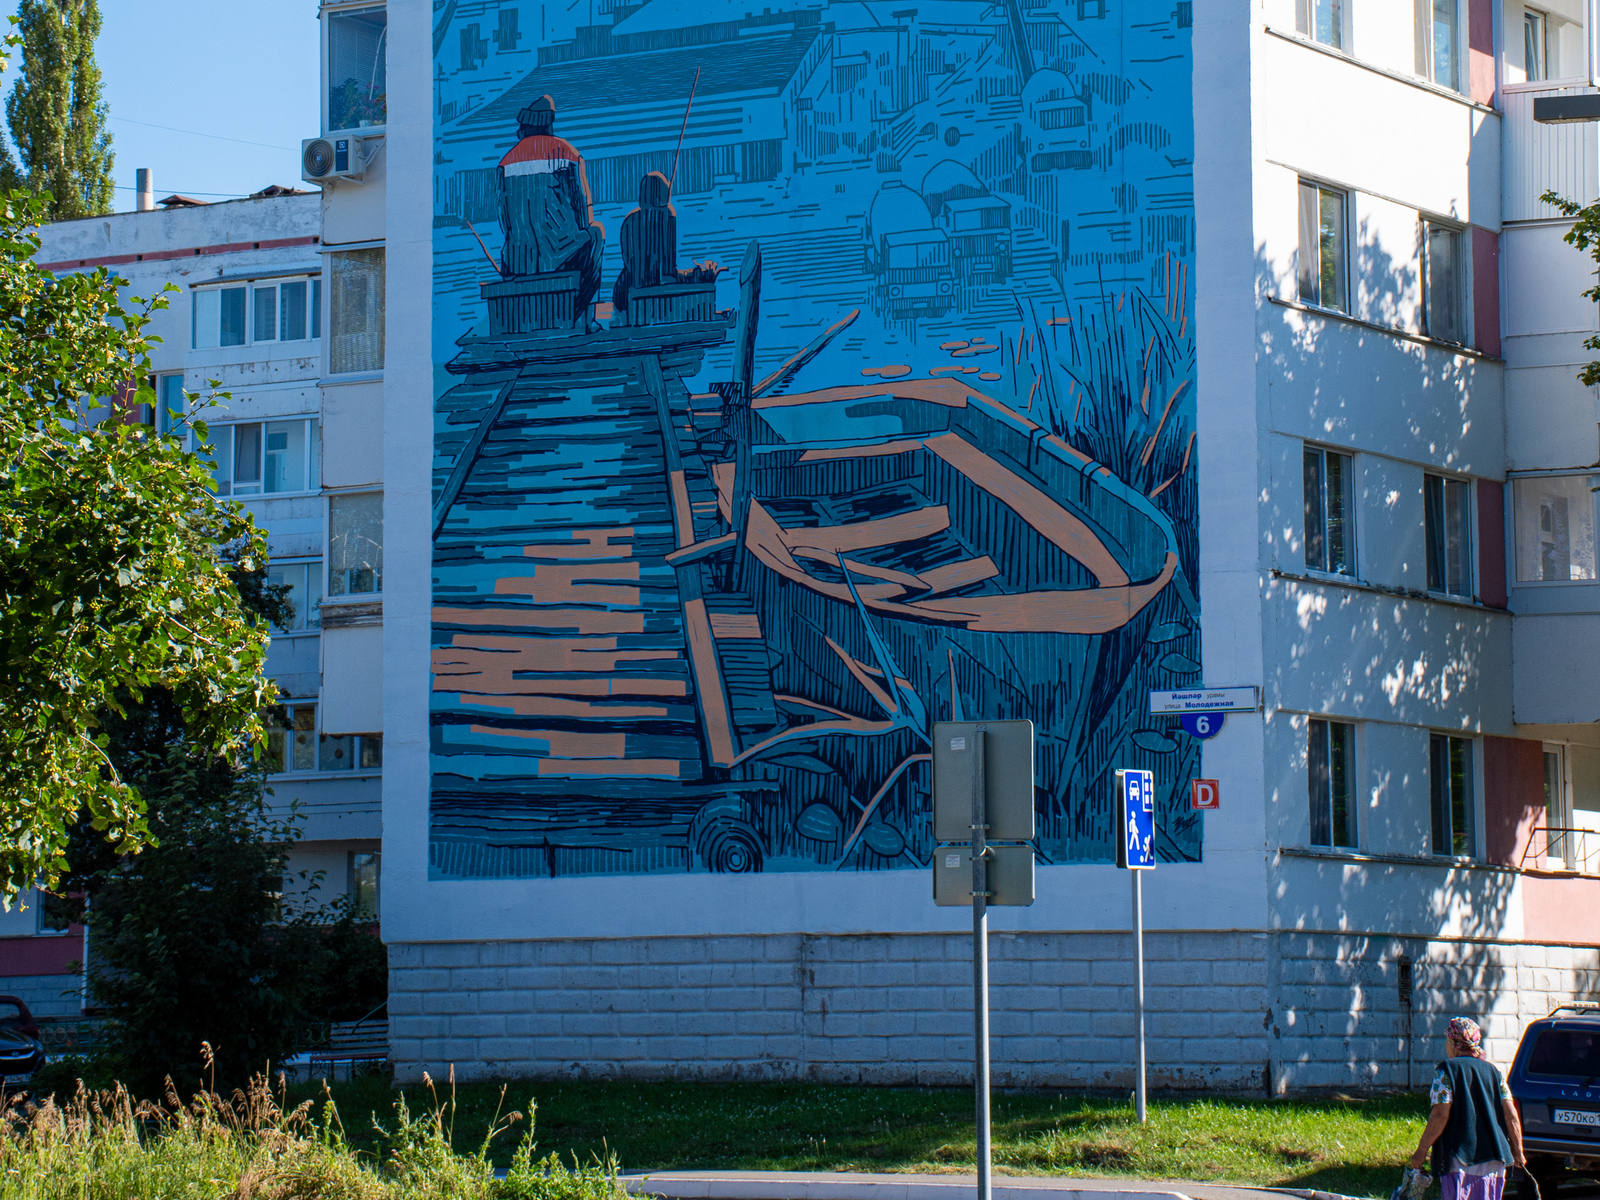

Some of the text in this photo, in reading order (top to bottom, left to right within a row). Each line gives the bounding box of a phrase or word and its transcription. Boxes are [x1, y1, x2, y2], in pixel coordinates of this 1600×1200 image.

[1184, 700, 1234, 709] Молодежная
[1196, 715, 1210, 734] 6
[1197, 784, 1214, 806] D
[1561, 1090, 1600, 1098] LAD
